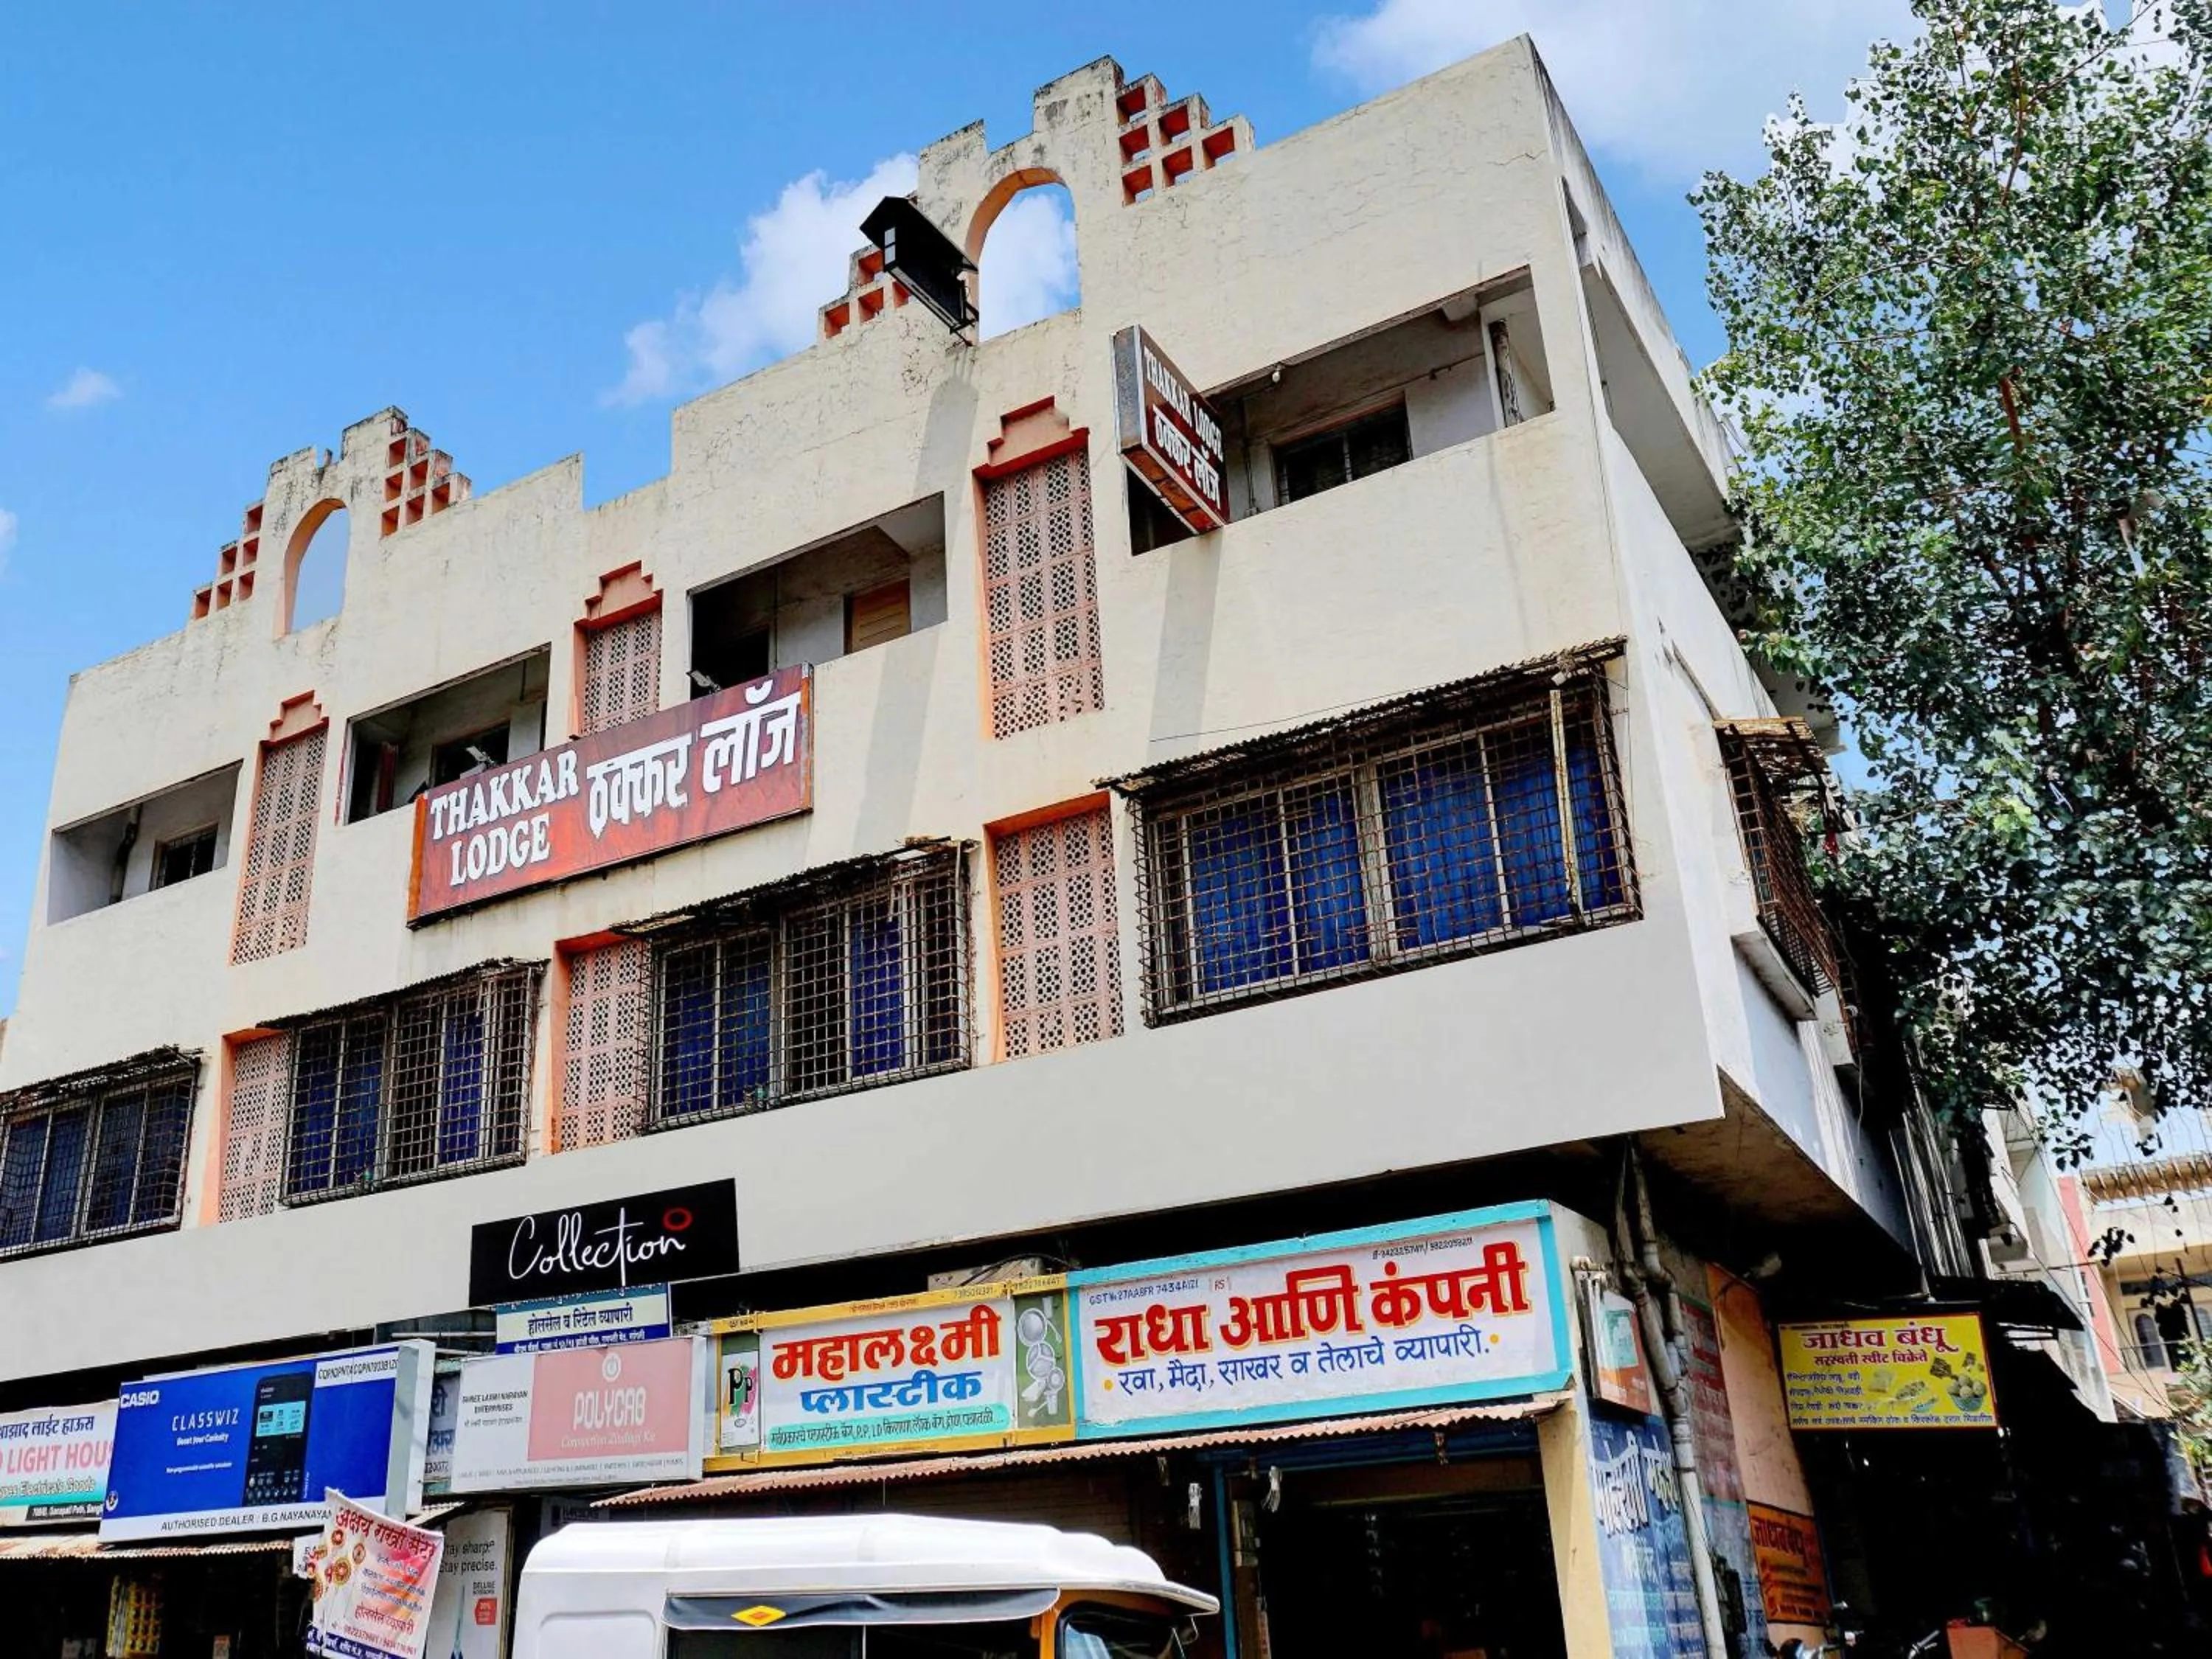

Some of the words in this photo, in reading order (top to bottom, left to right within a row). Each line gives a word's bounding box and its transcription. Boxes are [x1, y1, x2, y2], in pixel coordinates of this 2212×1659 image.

[1144, 345, 1192, 428] THAKKAR
[1193, 401, 1223, 462] LODGE
[700, 680, 801, 793] लॉज
[431, 750, 579, 840] THAKKAR
[451, 813, 550, 886] LODGE
[508, 1207, 686, 1286] Collection
[1094, 1303, 1212, 1366] राधा
[1220, 1264, 1365, 1349] आणि
[1369, 1241, 1531, 1328] कंपनी
[771, 1304, 1001, 1381] महालक्ष्मी
[1801, 1328, 1888, 1349] जाधव
[1894, 1321, 1959, 1352] बंधू
[1814, 1352, 1859, 1366] सरस्वती
[1862, 1350, 1888, 1364] स्वीट
[1119, 1371, 1164, 1398] रवा,
[1220, 1353, 1281, 1388] साखर
[1290, 1352, 1309, 1374] व
[1317, 1335, 1385, 1371] तेलाचे
[120, 1390, 159, 1408] CASIO
[573, 1386, 646, 1431] POLYCAB
[800, 1369, 983, 1414] प्लास्टीक
[32, 1413, 60, 1437] लाईट
[62, 1416, 94, 1436] हाऊस
[172, 1408, 239, 1431] CLASSWIZ
[7, 1445, 61, 1474] LIGHT
[161, 1518, 216, 1531] AUTHORISED
[219, 1514, 254, 1527] DEALER
[336, 1507, 372, 1537] अक्षय
